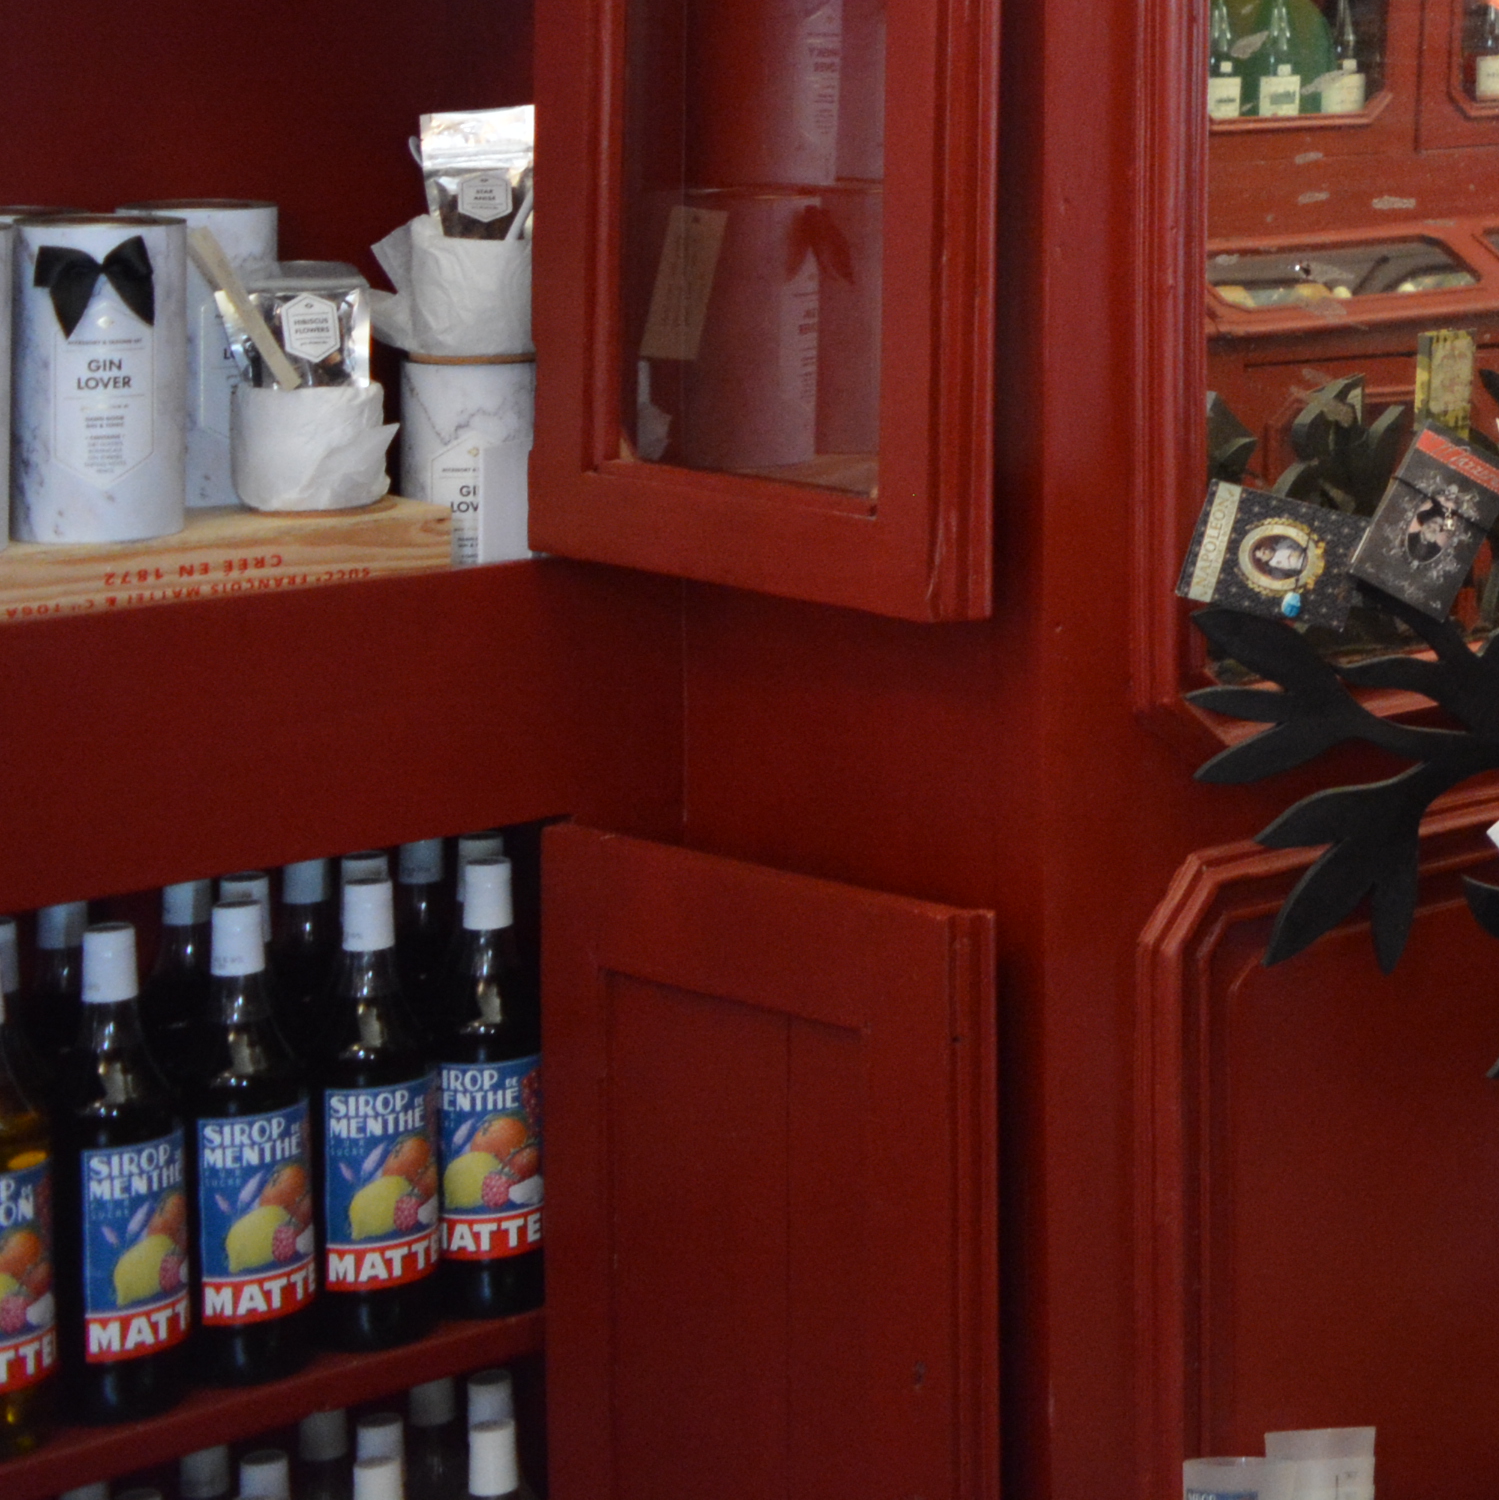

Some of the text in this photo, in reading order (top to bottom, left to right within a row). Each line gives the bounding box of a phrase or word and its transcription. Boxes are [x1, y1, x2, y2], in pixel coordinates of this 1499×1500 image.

[87, 358, 122, 372] GIN
[77, 376, 132, 391] LOVER
[104, 554, 283, 586] CRÉÉ EN 1872
[211, 572, 308, 594] FRANÇOIS
[128, 587, 200, 606] MATTEI
[330, 1090, 409, 1118] SIROP
[203, 1117, 285, 1147] SIROP
[330, 1108, 425, 1139] MENTHE
[89, 1144, 171, 1178] SIROP
[204, 1135, 301, 1169] MENTHE
[89, 1163, 183, 1201] MENTHE
